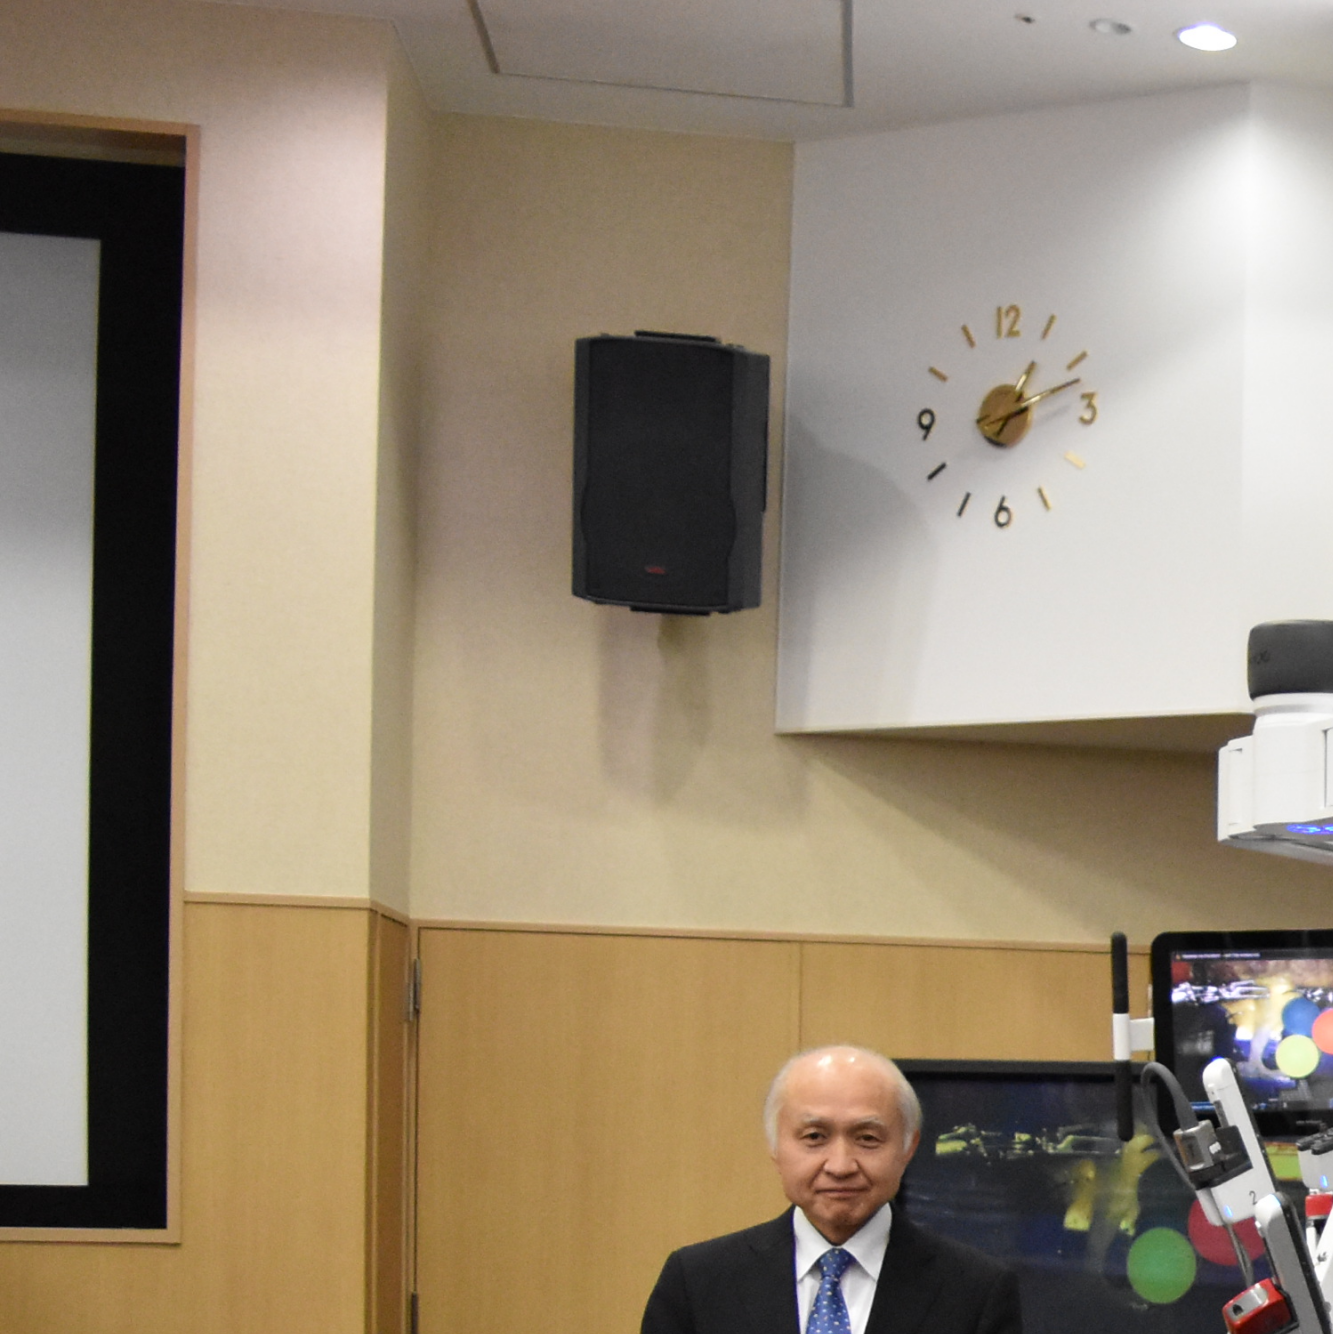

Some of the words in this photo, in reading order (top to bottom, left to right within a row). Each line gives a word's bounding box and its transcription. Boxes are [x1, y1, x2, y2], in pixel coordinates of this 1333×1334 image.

[996, 304, 1021, 339] 12
[917, 408, 936, 441] 9
[1078, 391, 1098, 426] 3
[994, 495, 1012, 528] 6
